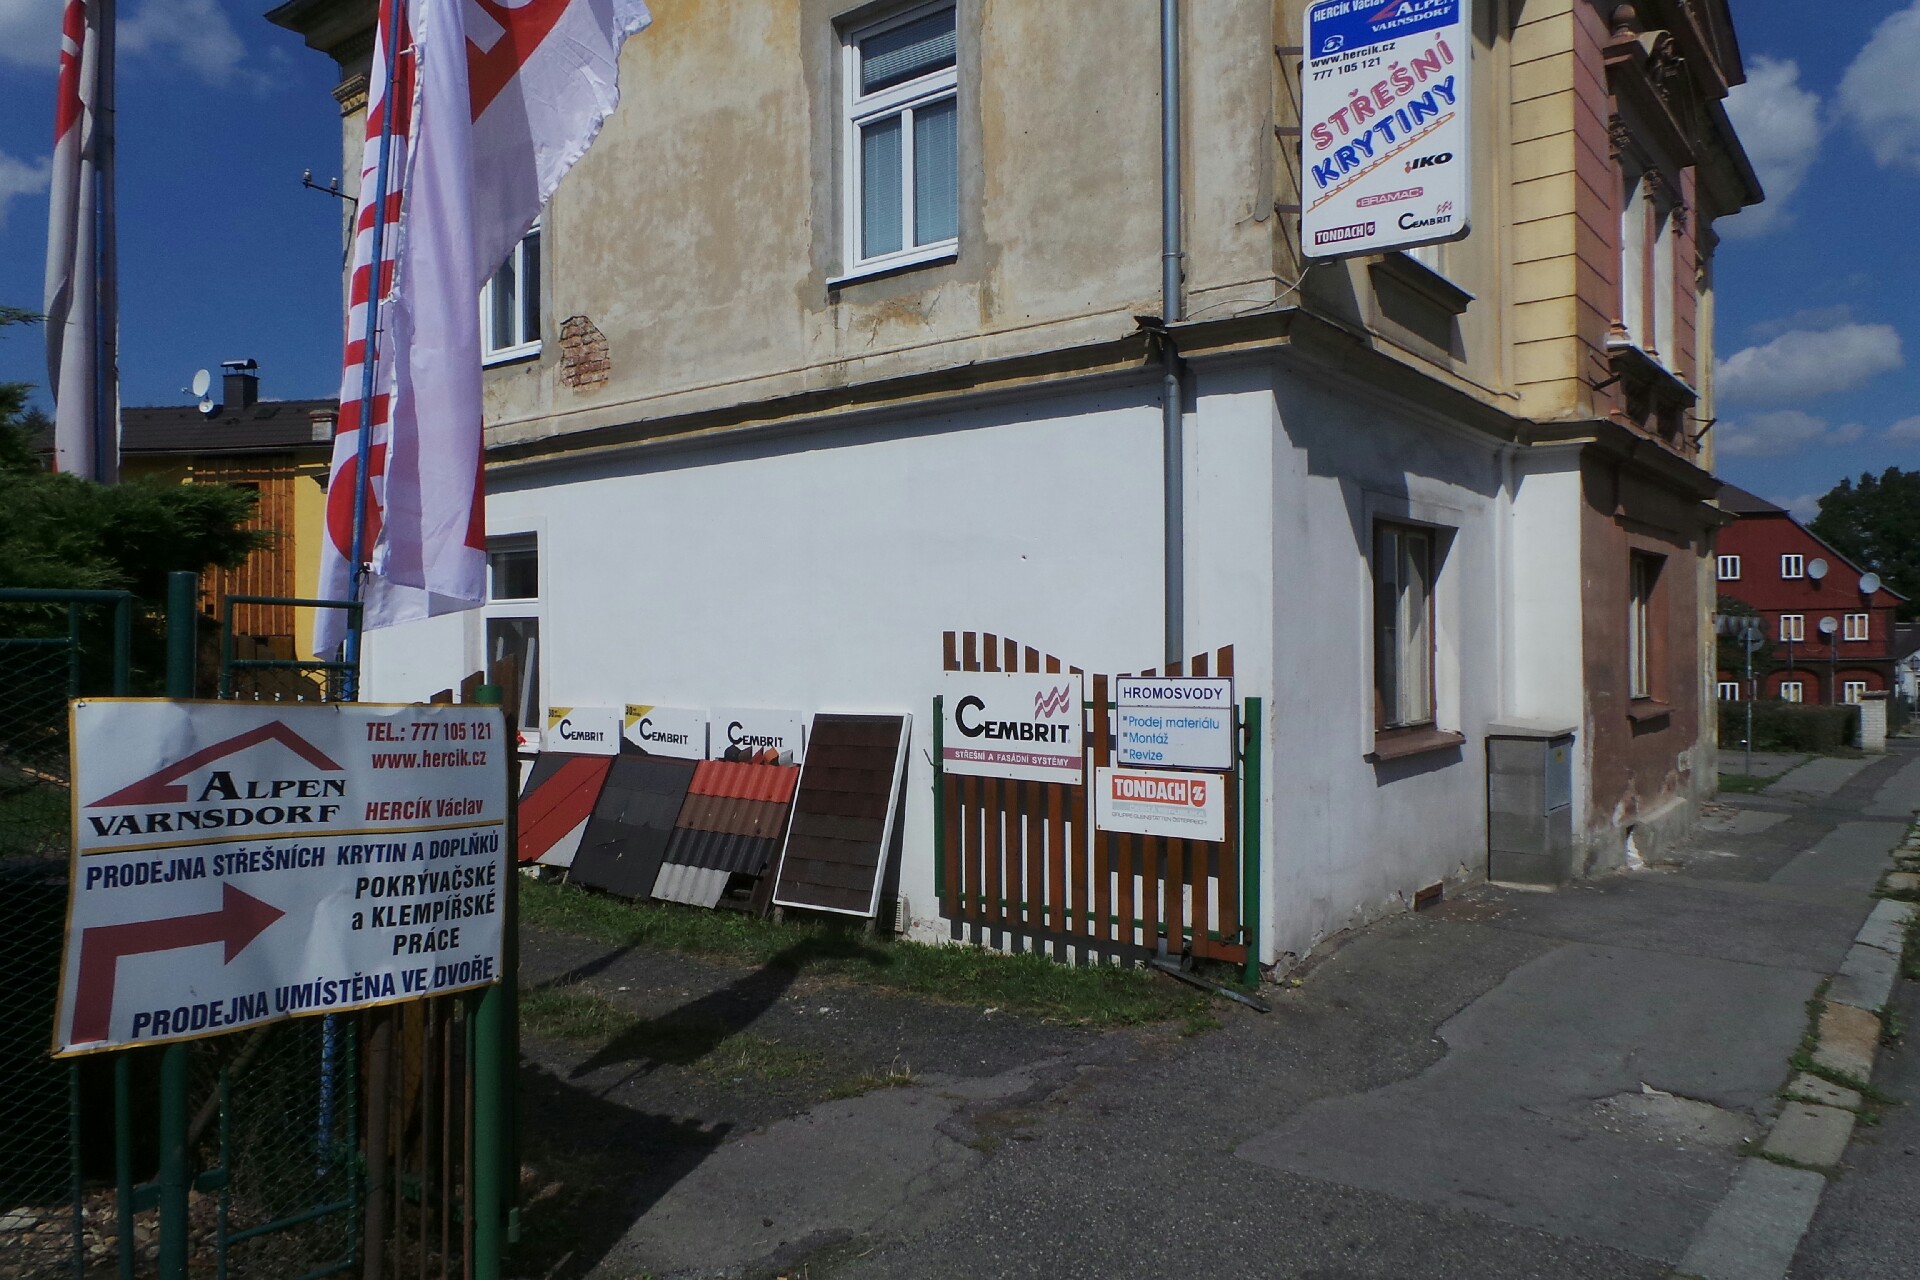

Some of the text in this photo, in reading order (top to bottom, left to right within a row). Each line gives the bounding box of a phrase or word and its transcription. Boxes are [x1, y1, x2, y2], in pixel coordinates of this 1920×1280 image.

[1314, 1, 1350, 22] HERCÍK
[1372, 6, 1451, 32] VARNSDORF
[1311, 42, 1396, 68] www.hercik.cz
[1313, 57, 1381, 81] 777 105 121
[1311, 32, 1454, 150] STŘEŠNÍ
[1311, 75, 1455, 189] KRYTINY
[1361, 188, 1419, 207] BRAMAC
[1398, 212, 1452, 230] CEMBRIT
[1316, 224, 1364, 244] TONDACH
[1123, 687, 1223, 700] HROMOSVODY
[560, 718, 604, 741] CEMBRIT
[639, 717, 689, 745] CEMBRIT
[955, 695, 1069, 743] CEMBRIT
[1128, 716, 1220, 730] Prodej materiálu
[366, 722, 491, 741] TEL.: 777 105 121
[727, 721, 784, 747] CEMBRIT
[1129, 732, 1169, 745] Montáž
[372, 748, 487, 769] www.hercik.cz
[955, 749, 1069, 767] STŘEŠNÍ A FASÁDNÍ SYSTÉMY
[1129, 748, 1163, 760] Revize
[196, 771, 347, 801] ALPEN
[1114, 778, 1186, 802] TONDACH
[87, 804, 341, 837] VARNSDORF
[365, 797, 484, 821] HERCÍK Václav
[86, 830, 499, 890] PRODEJNA STŘEŠNÍCH KRYTIN A DOPLŇKŮ
[355, 860, 496, 899] POKRÝVAČSKÉ
[352, 888, 496, 930] a KLEMPÍŘSKÉ
[393, 927, 460, 956] PRÁCE
[132, 955, 494, 1038] PRODEJNA UMÍSTĚNA VE DVOŘE
